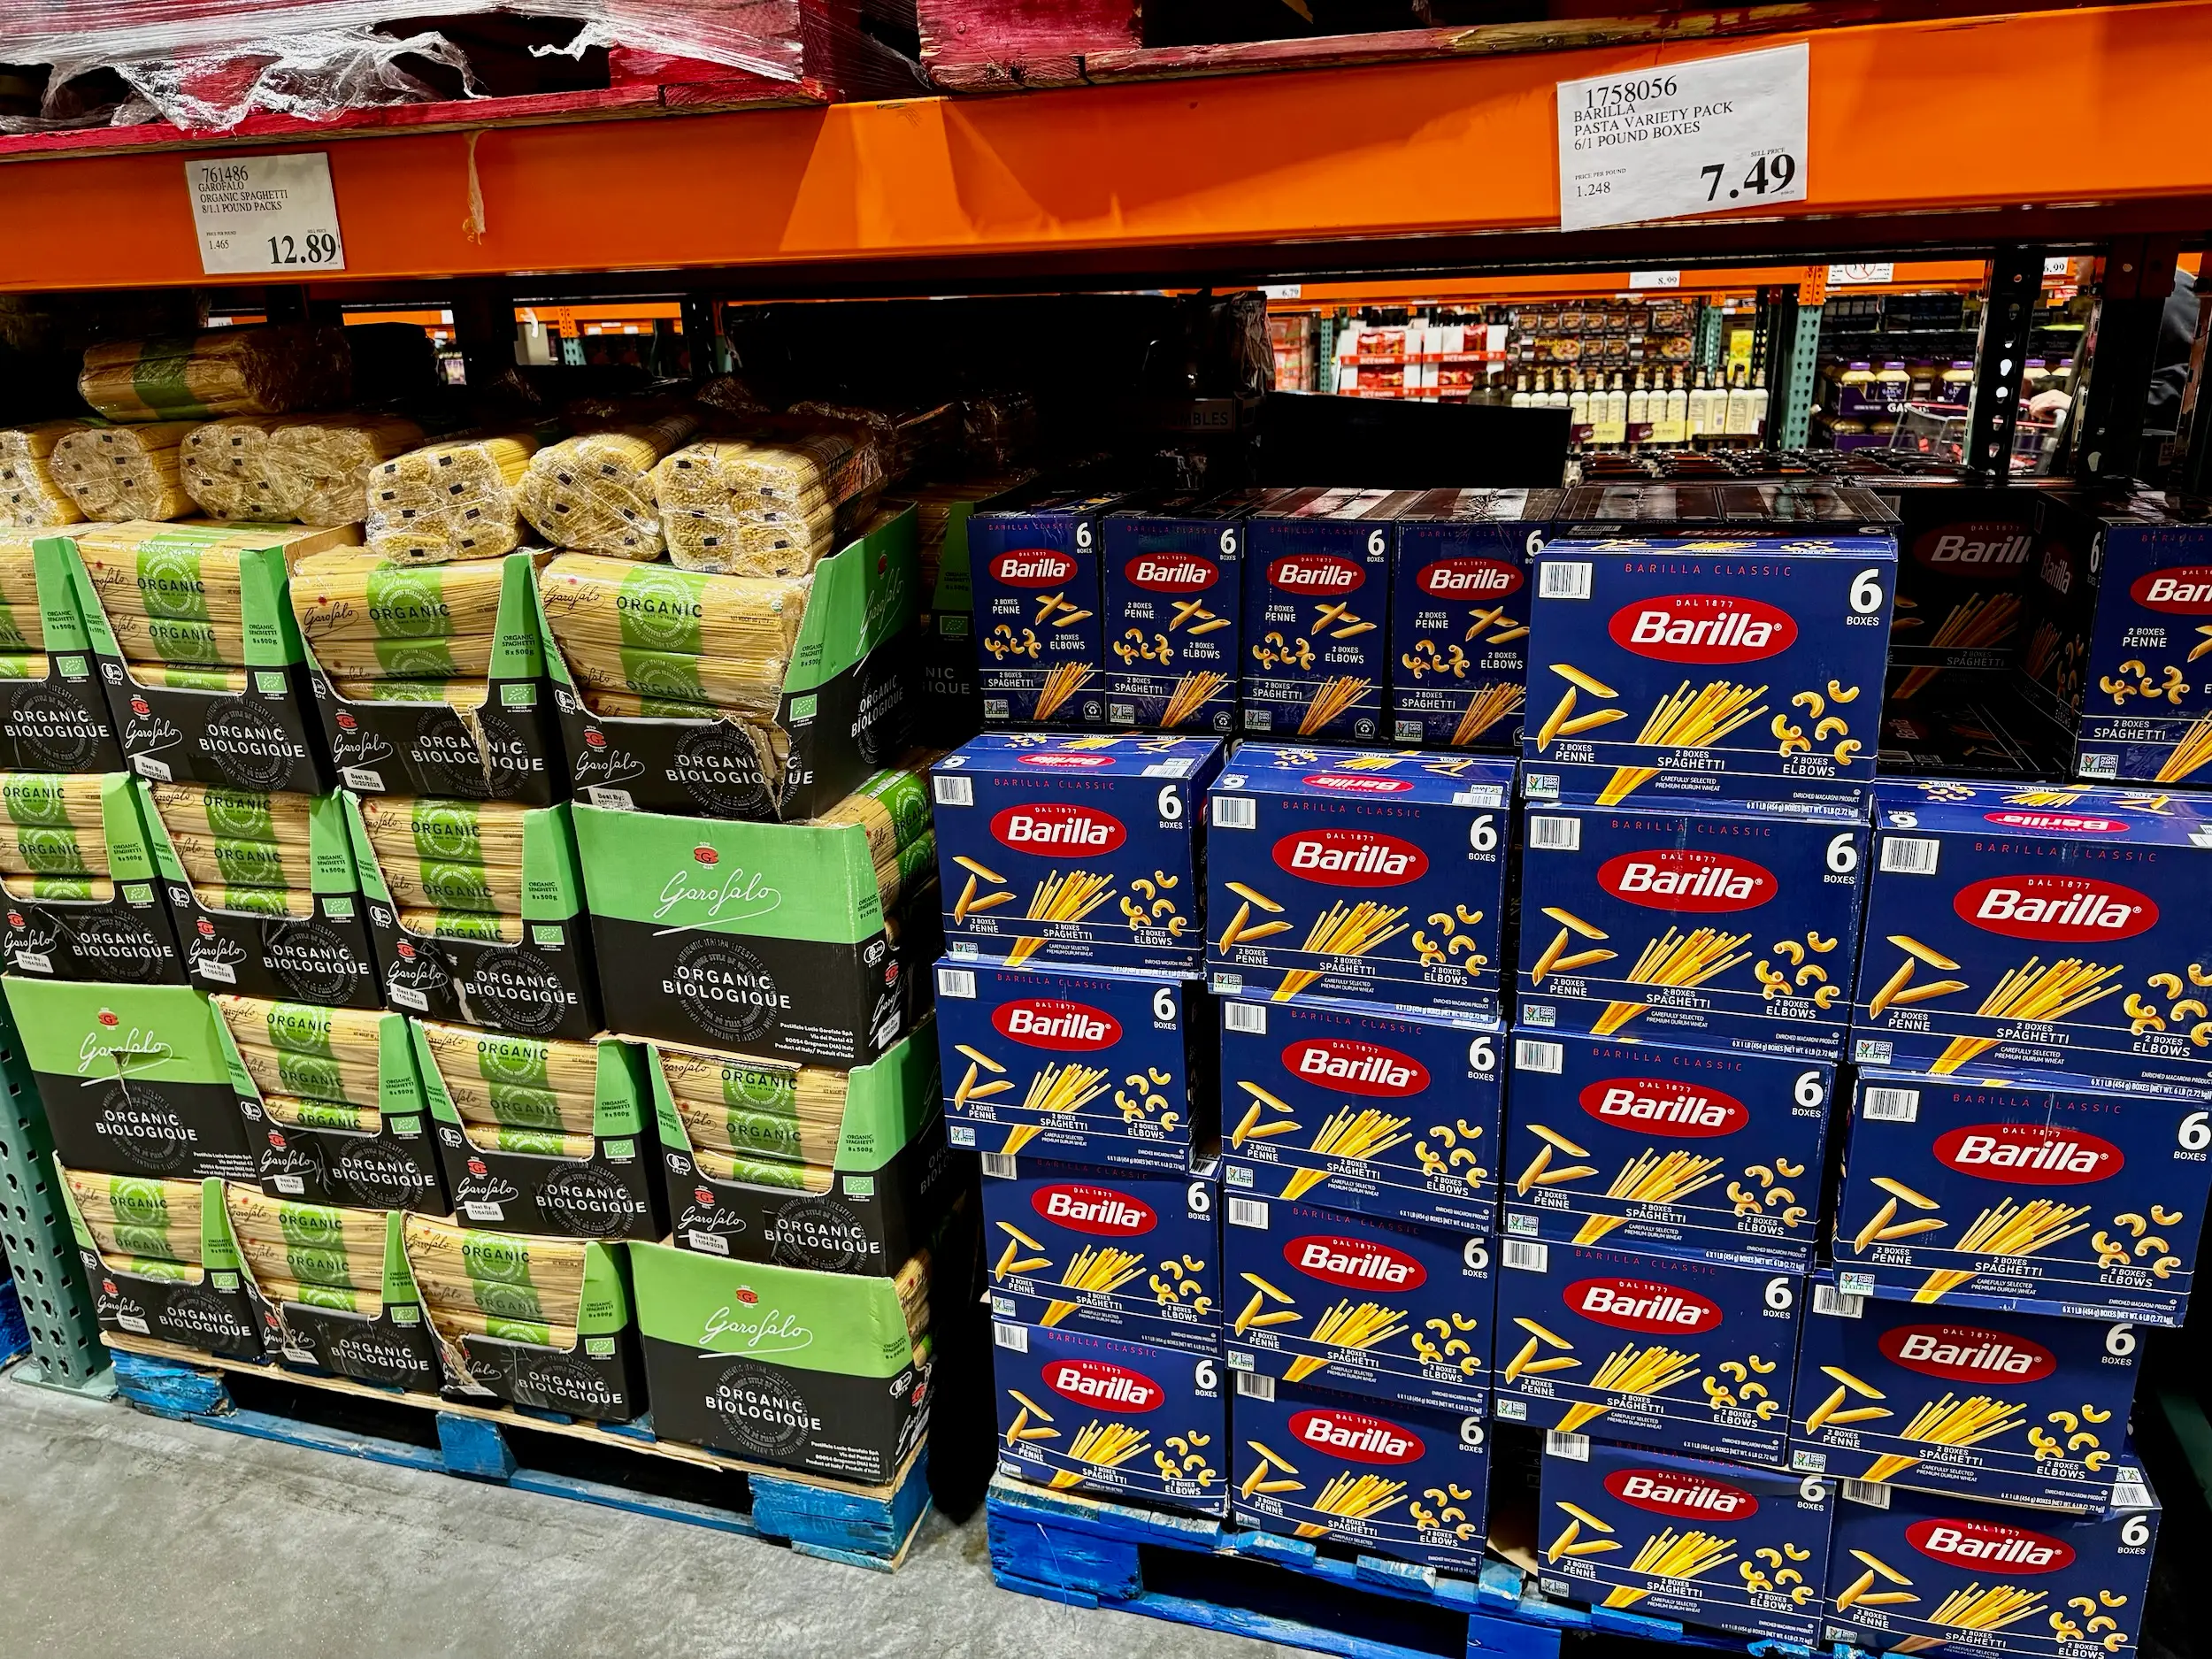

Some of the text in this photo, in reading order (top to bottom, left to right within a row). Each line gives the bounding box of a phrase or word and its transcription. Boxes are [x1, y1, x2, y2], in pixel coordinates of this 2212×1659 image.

[1586, 75, 1677, 109] 1758056
[1574, 104, 1635, 122] BARILLA
[1575, 101, 1733, 135] PASTA VARIETY PACK
[1574, 121, 1701, 150] 6/1 POUND BOXES
[202, 165, 248, 182] 761486
[1701, 154, 1795, 201] 7.49
[198, 181, 243, 192] GAROFALO
[201, 190, 288, 203] ORGANIC SPAGHETTI
[1577, 181, 1610, 197] 1.248
[202, 202, 282, 213] 8/1.1 POUND PACKS
[209, 240, 229, 250] 1.465
[268, 234, 336, 264] 12.89
[1077, 522, 1092, 547] 6
[1931, 535, 2032, 563] Barill
[1001, 559, 1066, 577] Barilla
[1137, 563, 1207, 583] Barilla
[1279, 565, 1353, 586] Barilla
[1625, 563, 1793, 577] BARILLA CLASSIC
[2040, 552, 2071, 595] Barilla
[137, 578, 205, 594] ORGANIC
[1430, 570, 1509, 589] Barilla
[1849, 568, 1883, 613] 6
[369, 604, 450, 620] ORGANIC
[616, 595, 703, 618] ORGANIC
[993, 605, 1020, 614] PENNE
[1265, 612, 1296, 622] PENNE
[1847, 616, 1879, 626] BOXES
[149, 625, 216, 641] ORGANIC
[1631, 611, 1773, 648] Barilla
[1050, 641, 1085, 649] ELBOWS
[2123, 637, 2168, 648] PENNE
[1325, 653, 1363, 664] ELBOWS
[988, 679, 1033, 687] SPAGHETTI
[1252, 688, 1302, 700] SPAGHETTI
[12, 710, 89, 723] ORGANIC
[4, 725, 110, 738] BIOLOGIQUE
[208, 724, 285, 741] ORGANIC
[2093, 728, 2166, 741] SPAGHETTI
[198, 737, 306, 758] BIOLOGIQUE
[419, 735, 522, 755] ORGANIC
[1675, 749, 1682, 758] 2
[1555, 751, 1594, 763] PENNE
[1657, 757, 1725, 770] SPAGHETTI
[1802, 757, 1828, 765] BOXES
[1783, 764, 1835, 777] ELBOWS
[3, 786, 65, 799] ORGANIC
[1158, 785, 1182, 820] 6
[411, 821, 480, 837] ORGANIC
[1008, 816, 1109, 845] Barilla
[1470, 815, 1497, 851] 6
[1291, 841, 1409, 875] Barilla
[1826, 833, 1858, 872] 6
[1619, 864, 1755, 900] Barilla
[1977, 889, 2131, 928] Barilla
[80, 932, 154, 945] ORGANIC
[73, 945, 174, 958] BIOLOGIQUE
[476, 970, 557, 989] ORGANIC
[677, 965, 772, 990] ORGANIC
[465, 982, 578, 1005] BIOLOGIQUE
[663, 979, 792, 1010] BIOLOGIQUE
[1009, 1009, 1105, 1041] Barilla
[1887, 1018, 1931, 1031] PENNE
[1996, 1028, 2070, 1044] SPAGHETTI
[477, 1041, 549, 1060] ORGANIC
[1468, 1037, 1495, 1071] 6
[2132, 1041, 2191, 1057] ELBOWS
[1300, 1048, 1411, 1087] Barilla
[721, 1069, 798, 1090] ORGANIC
[104, 1110, 179, 1126] ORGANIC
[1600, 1089, 1727, 1127] Barilla
[96, 1122, 198, 1141] BIOLOGIQUE
[2177, 1112, 2211, 1150] 6
[1955, 1136, 2101, 1173] Barilla
[341, 1157, 418, 1174] ORGANIC
[331, 1167, 435, 1187] BIOLOGIQUE
[547, 1183, 627, 1200] ORGANIC
[535, 1194, 647, 1214] BIOLOGIQUE
[1047, 1193, 1141, 1228] Barilla
[777, 1219, 863, 1240] ORGANIC
[764, 1230, 881, 1255] BIOLOGIQUE
[1301, 1244, 1409, 1284] Barilla
[1764, 1277, 1793, 1310] 6
[166, 1306, 234, 1325] ORGANIC
[1581, 1286, 1703, 1325] Barilla
[158, 1315, 251, 1337] BIOLOGIQUE
[1899, 1334, 2034, 1374] Barilla
[1056, 1368, 1148, 1405] Barilla
[718, 1385, 803, 1414] ORGANIC
[705, 1396, 822, 1431] BIOLOGIQUE
[1304, 1417, 1408, 1457] Barilla
[1622, 1477, 1739, 1513] Barilla
[2122, 1516, 2149, 1547] 6
[1924, 1527, 2055, 1566] Barilla
